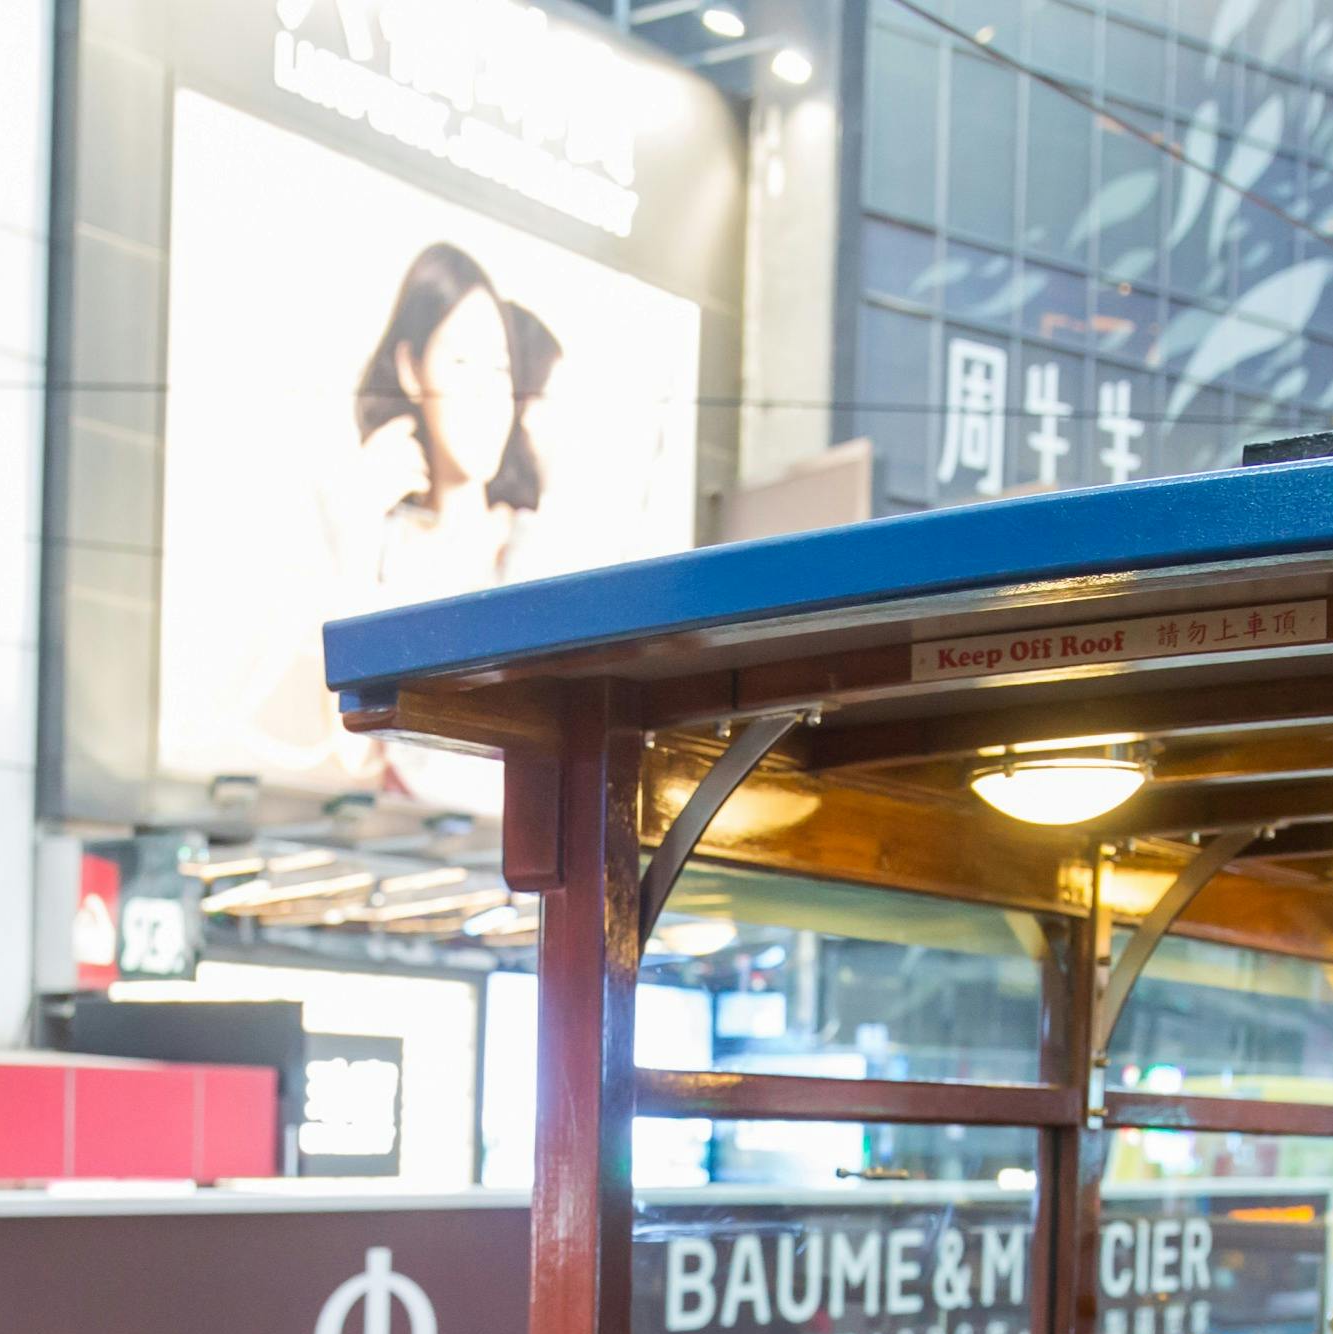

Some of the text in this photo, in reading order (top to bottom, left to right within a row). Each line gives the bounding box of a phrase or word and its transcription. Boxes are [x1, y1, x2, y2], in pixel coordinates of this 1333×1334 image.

[937, 609, 1298, 670] Keep Off Roof 請勿上車頂
[665, 1228, 924, 1332] BAUME
[980, 1217, 1213, 1307] MCIER
